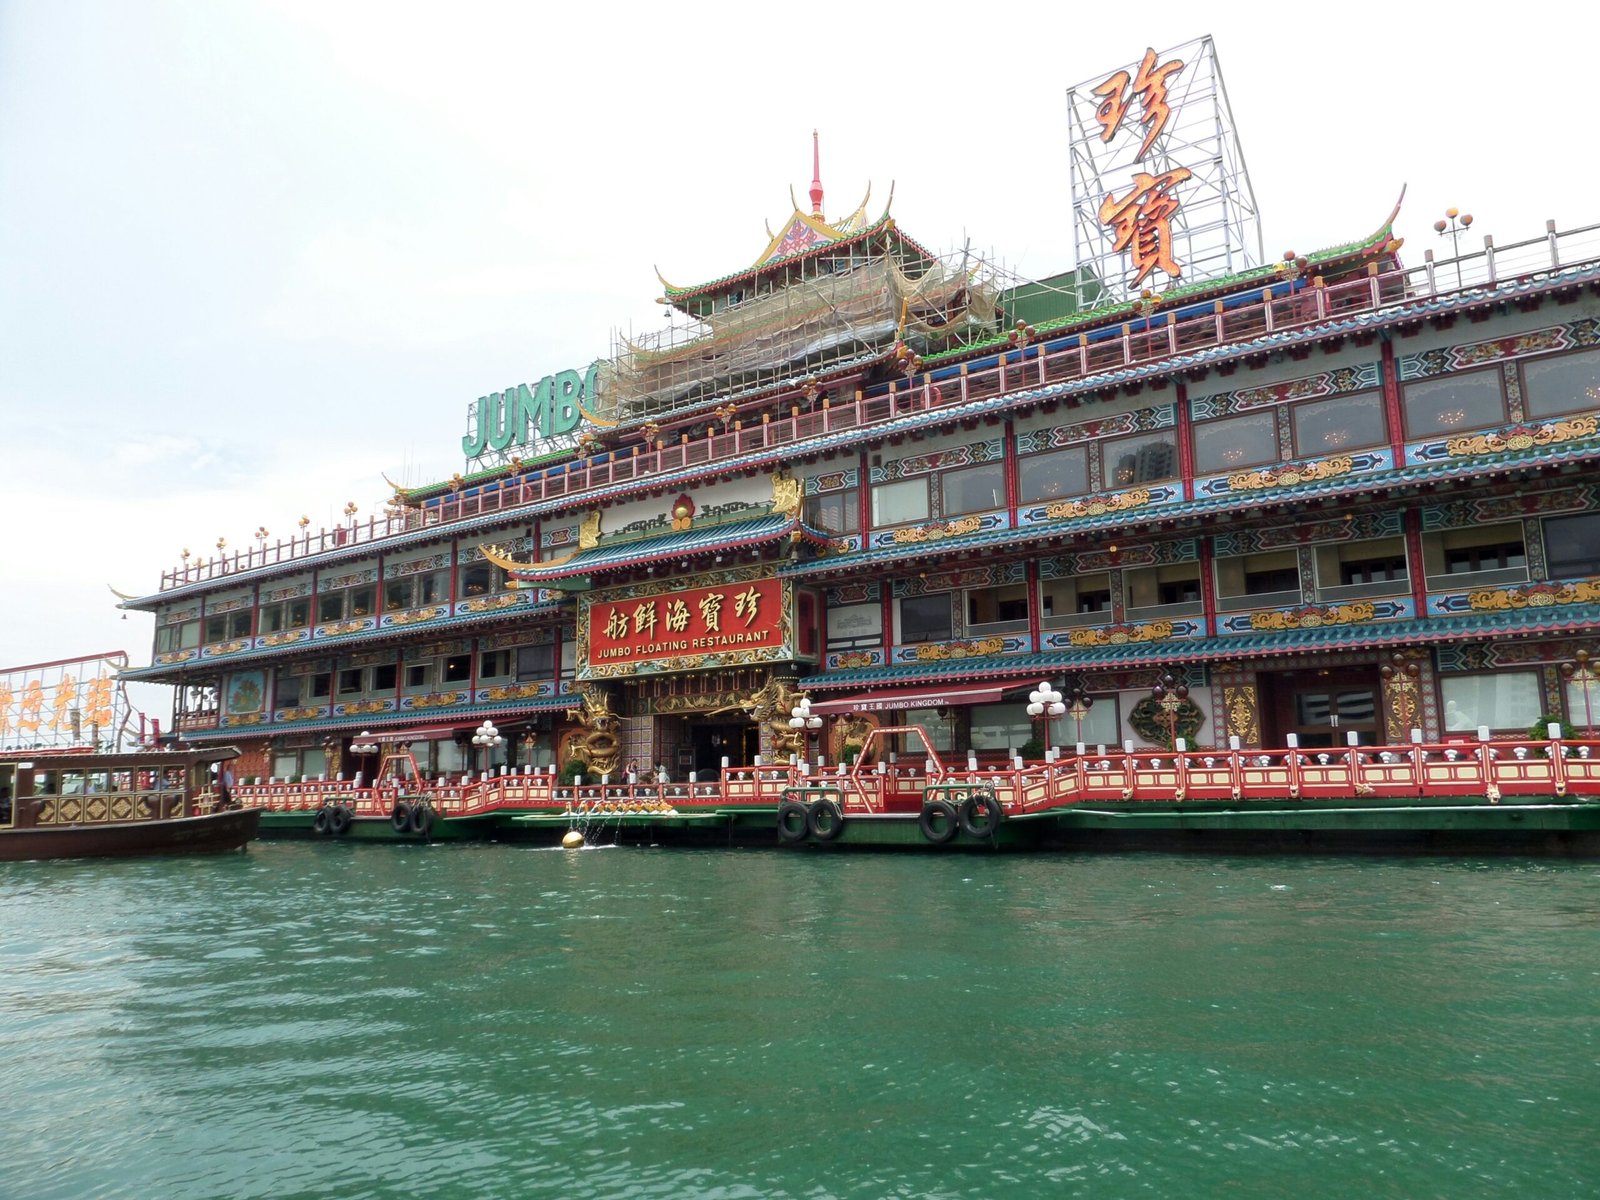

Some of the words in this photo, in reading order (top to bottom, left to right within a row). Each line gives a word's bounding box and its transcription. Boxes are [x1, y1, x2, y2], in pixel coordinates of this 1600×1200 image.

[597, 646, 631, 659] JUMBO
[635, 639, 688, 654] FLOATING
[692, 629, 769, 648] RESTAURANT
[885, 701, 909, 710] JUMBO
[910, 698, 944, 708] KINGDOM
